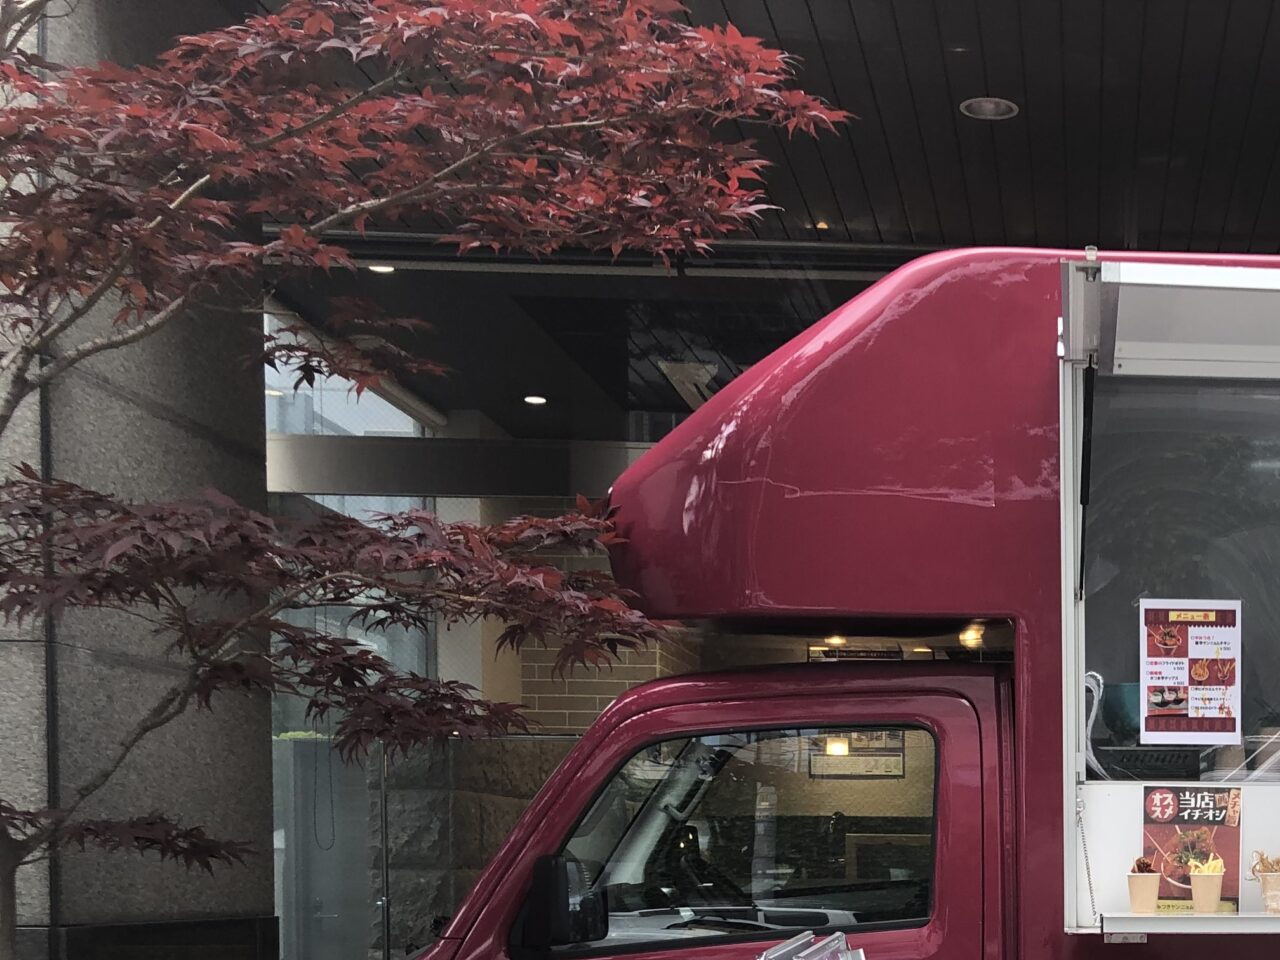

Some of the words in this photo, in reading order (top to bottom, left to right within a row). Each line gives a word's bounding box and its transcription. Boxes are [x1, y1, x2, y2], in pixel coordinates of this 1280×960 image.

[1179, 791, 1214, 808] 当店
[1179, 809, 1226, 820] イチオシ
